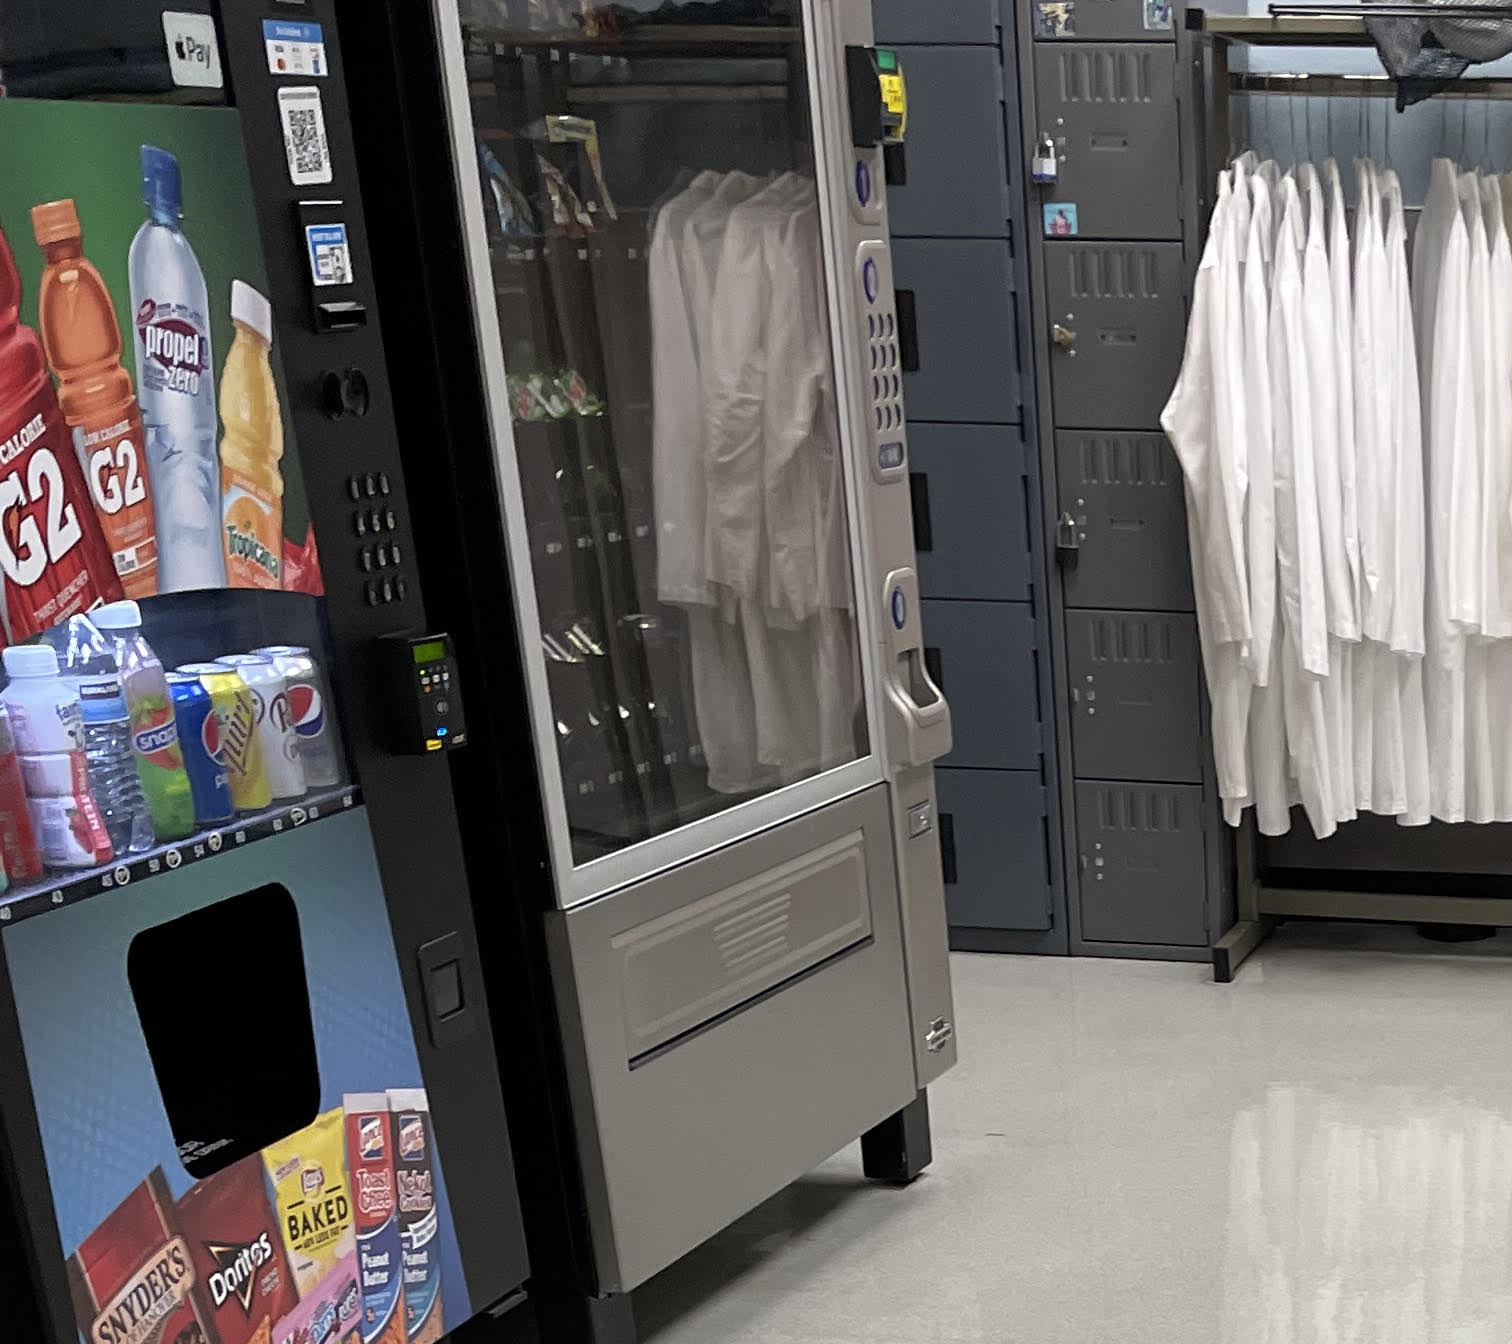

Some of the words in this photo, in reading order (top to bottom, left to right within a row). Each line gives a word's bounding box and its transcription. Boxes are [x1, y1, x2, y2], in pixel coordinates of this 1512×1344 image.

[184, 36, 211, 70] Pay
[144, 324, 200, 366] propel
[163, 364, 200, 397] zero
[88, 439, 147, 515] G2
[0, 447, 83, 587] G2
[287, 1195, 349, 1242] BAKED
[208, 1232, 272, 1306] Doritos
[361, 1251, 390, 1269] Peanut
